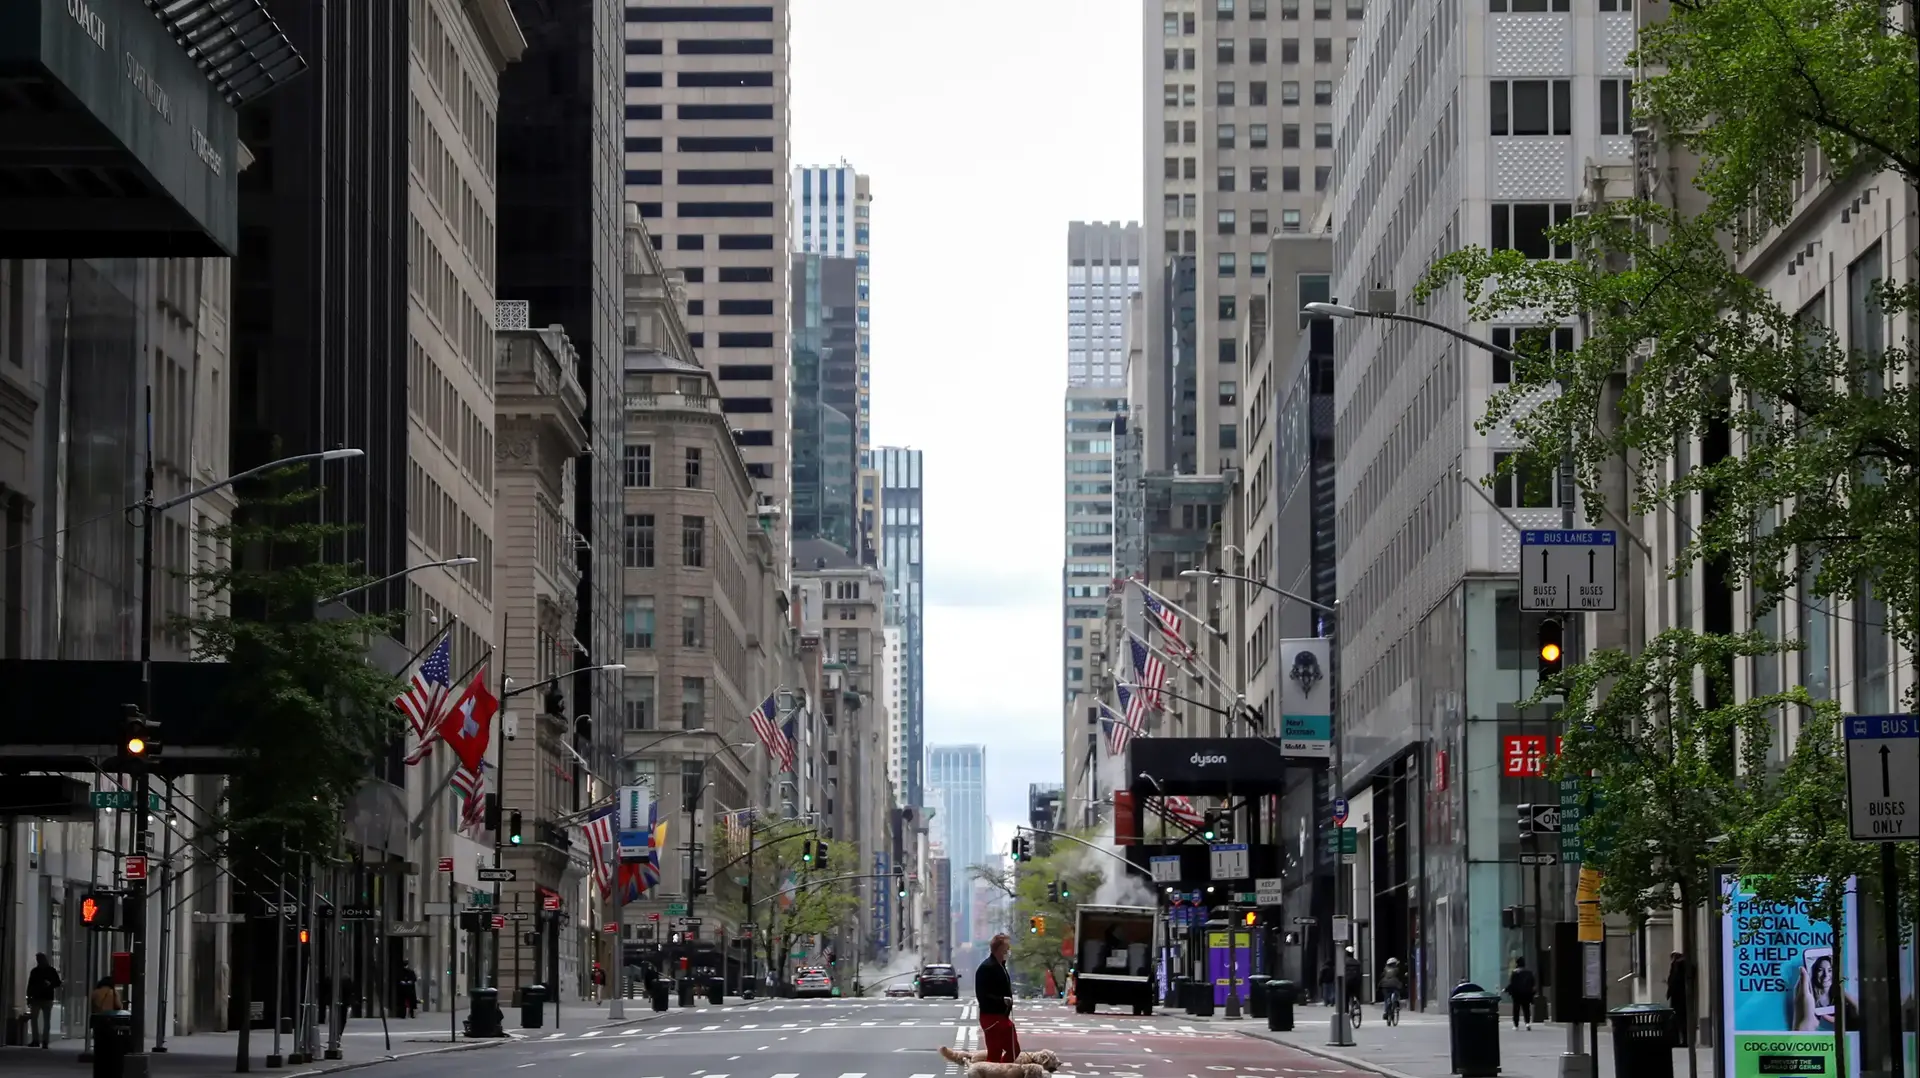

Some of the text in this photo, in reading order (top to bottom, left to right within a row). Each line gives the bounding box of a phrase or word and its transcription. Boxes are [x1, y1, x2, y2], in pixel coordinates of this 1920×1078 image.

[67, 0, 105, 51] COACH
[1543, 533, 1593, 543] BUS LANES
[1533, 585, 1557, 596] BUSES
[1579, 585, 1604, 596] BUSES
[1535, 598, 1555, 607] ONLY
[1581, 598, 1602, 607] ONLY
[1881, 720, 1908, 734] BUS
[1190, 752, 1227, 767] dyson
[1560, 780, 1578, 791] BM1
[95, 794, 101, 806] E
[106, 794, 118, 806] 54
[1560, 793, 1579, 805] BM2
[1561, 807, 1580, 819] BM3
[1869, 801, 1906, 816] BUSES
[1543, 813, 1560, 825] ON
[1561, 822, 1580, 833] BM4
[1872, 819, 1903, 834] ONLY
[1562, 836, 1580, 847] BM5
[1562, 852, 1580, 861] MTA
[1738, 901, 1809, 915] PRACTIC
[1738, 916, 1801, 930] SOCIAL
[1738, 947, 1799, 961] & HELP
[1739, 963, 1782, 977] SAVE
[1740, 978, 1789, 992] LIVES.
[1743, 1042, 1834, 1052] CDC.GOV/COVID1
